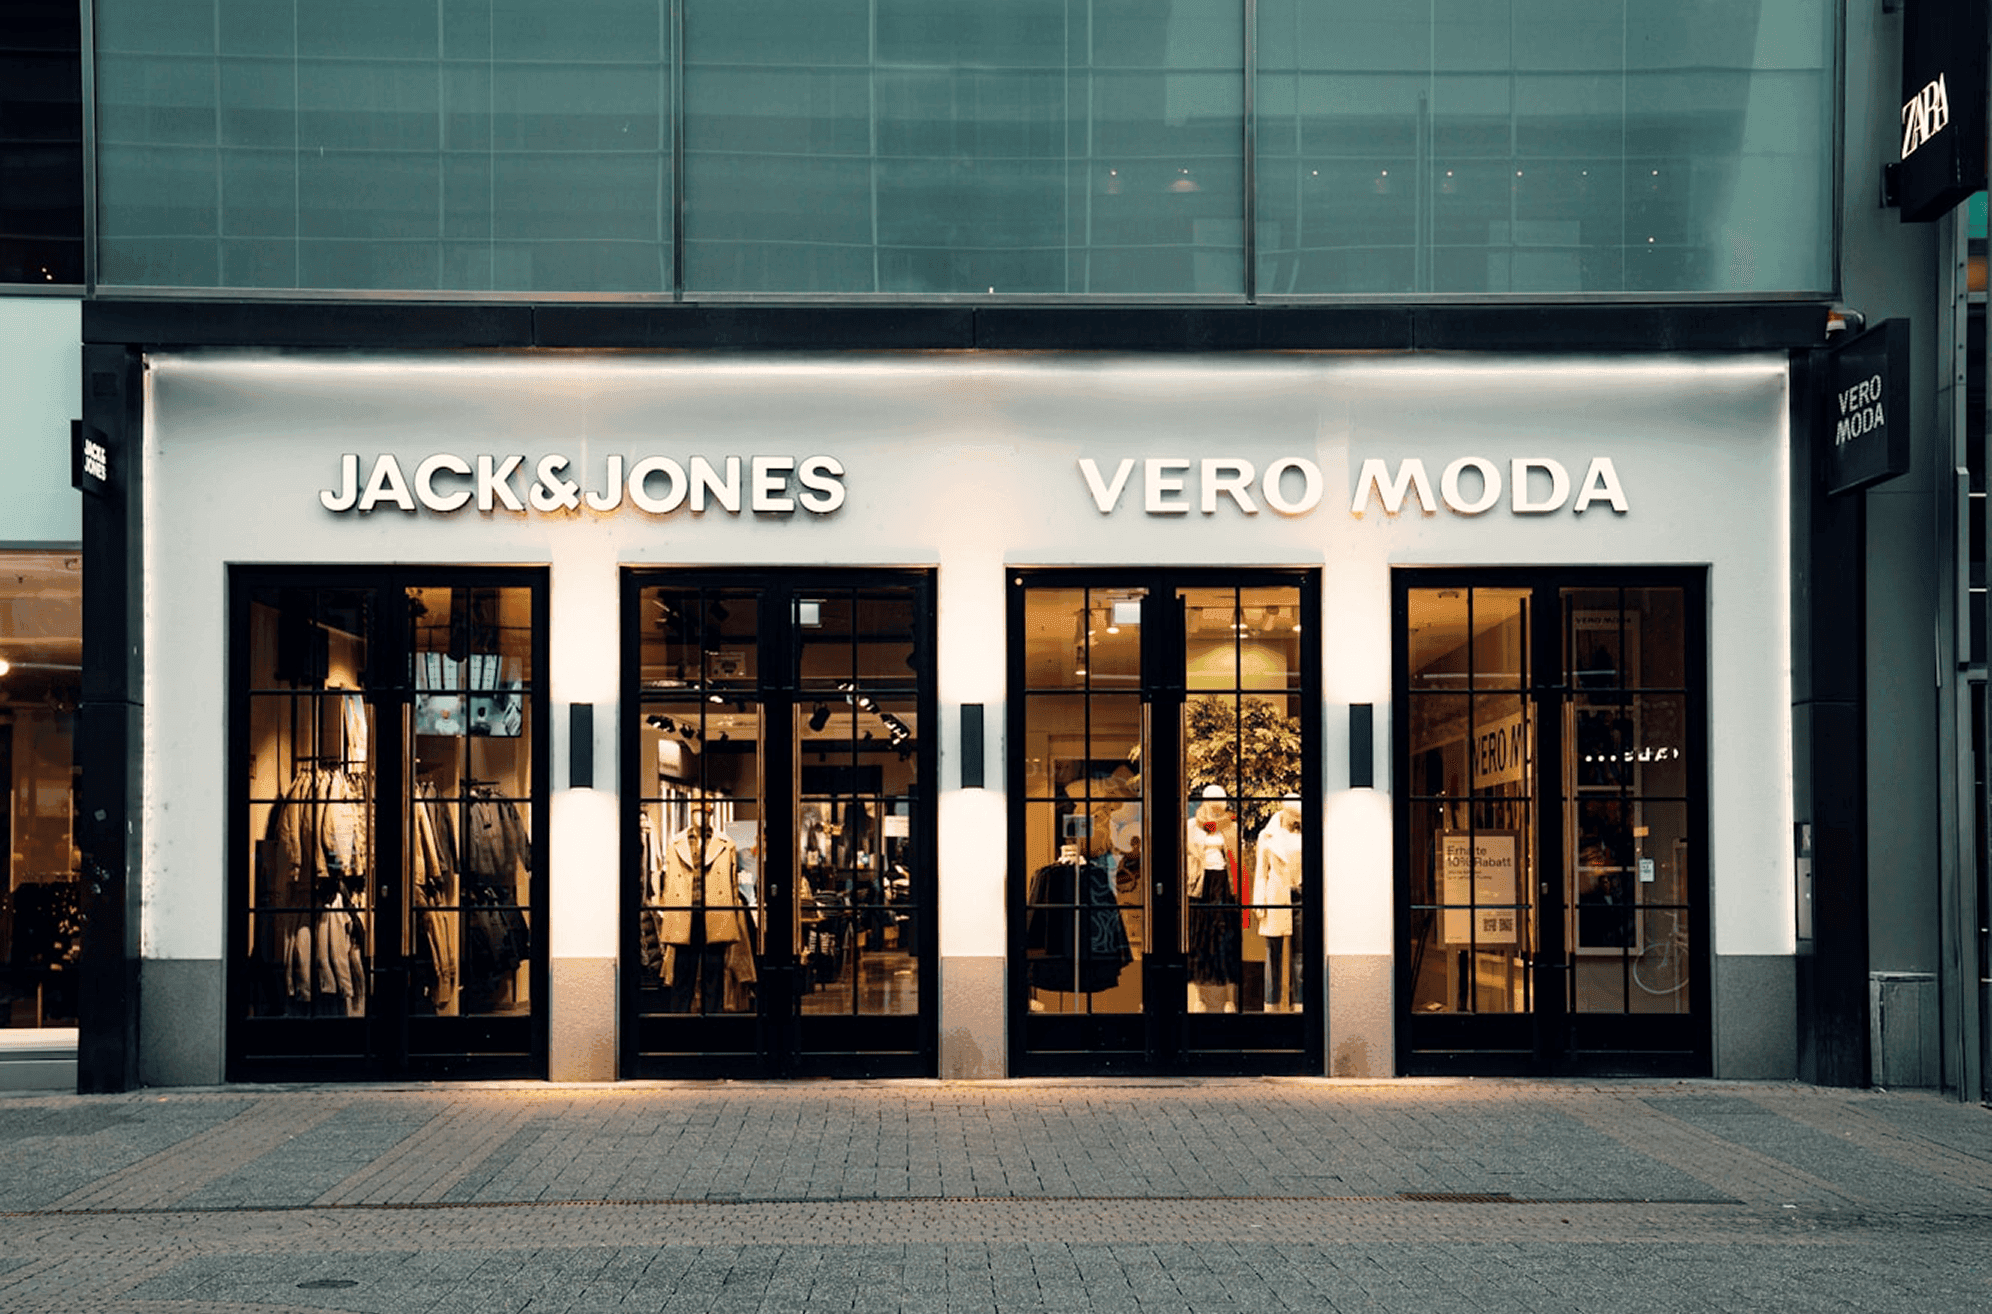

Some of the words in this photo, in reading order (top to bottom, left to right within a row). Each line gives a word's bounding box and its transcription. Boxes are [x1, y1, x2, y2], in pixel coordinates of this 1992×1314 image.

[1901, 72, 1949, 160] ZARA
[1838, 374, 1881, 415] VERO
[1835, 402, 1884, 446] MODA
[319, 453, 847, 514] JACK&JONES
[1078, 457, 1325, 515] VERO
[1350, 457, 1631, 515] MODA
[1473, 728, 1507, 777] VERO
[1474, 856, 1512, 867] Rabatt
